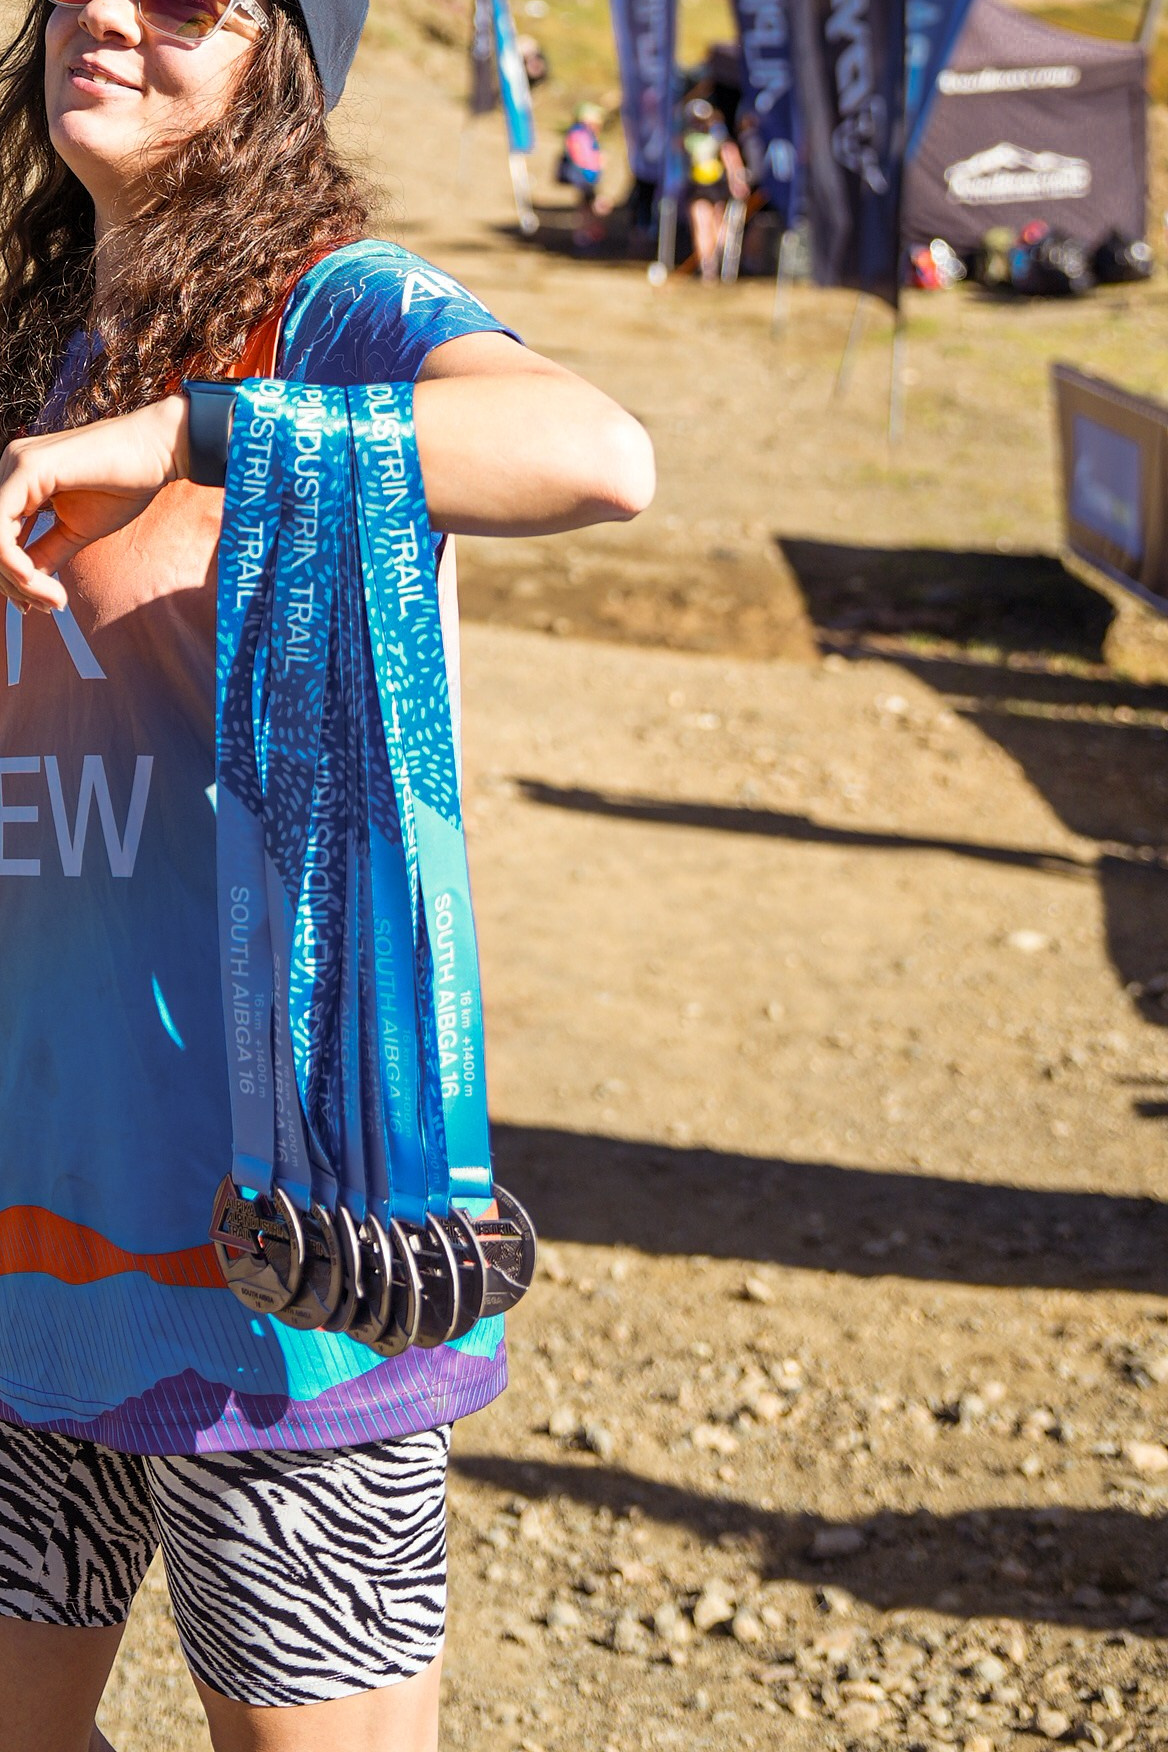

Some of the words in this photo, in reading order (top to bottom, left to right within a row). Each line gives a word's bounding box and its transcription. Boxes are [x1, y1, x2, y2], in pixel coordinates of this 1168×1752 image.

[240, 379, 286, 508] DUSTRIA
[291, 384, 323, 570] PINDUSTRIA
[366, 384, 409, 512] DUSTRIA
[388, 520, 424, 622] TRAIL
[236, 521, 264, 609] TRAIL
[284, 582, 315, 672] TRAIL
[230, 885, 249, 977] SOUTH
[374, 917, 397, 1012] SOUTH
[434, 892, 454, 985] SOUTH
[231, 983, 253, 1063] AIBGA
[437, 990, 459, 1070] AIBGA
[460, 990, 472, 1006] 16
[461, 1008, 471, 1029] km
[238, 1068, 255, 1096] 16
[383, 1017, 401, 1098] AIBGA
[441, 1071, 460, 1100] 16
[462, 1037, 475, 1082] +1400
[464, 1088, 473, 1098] m
[389, 1107, 402, 1134] 16
